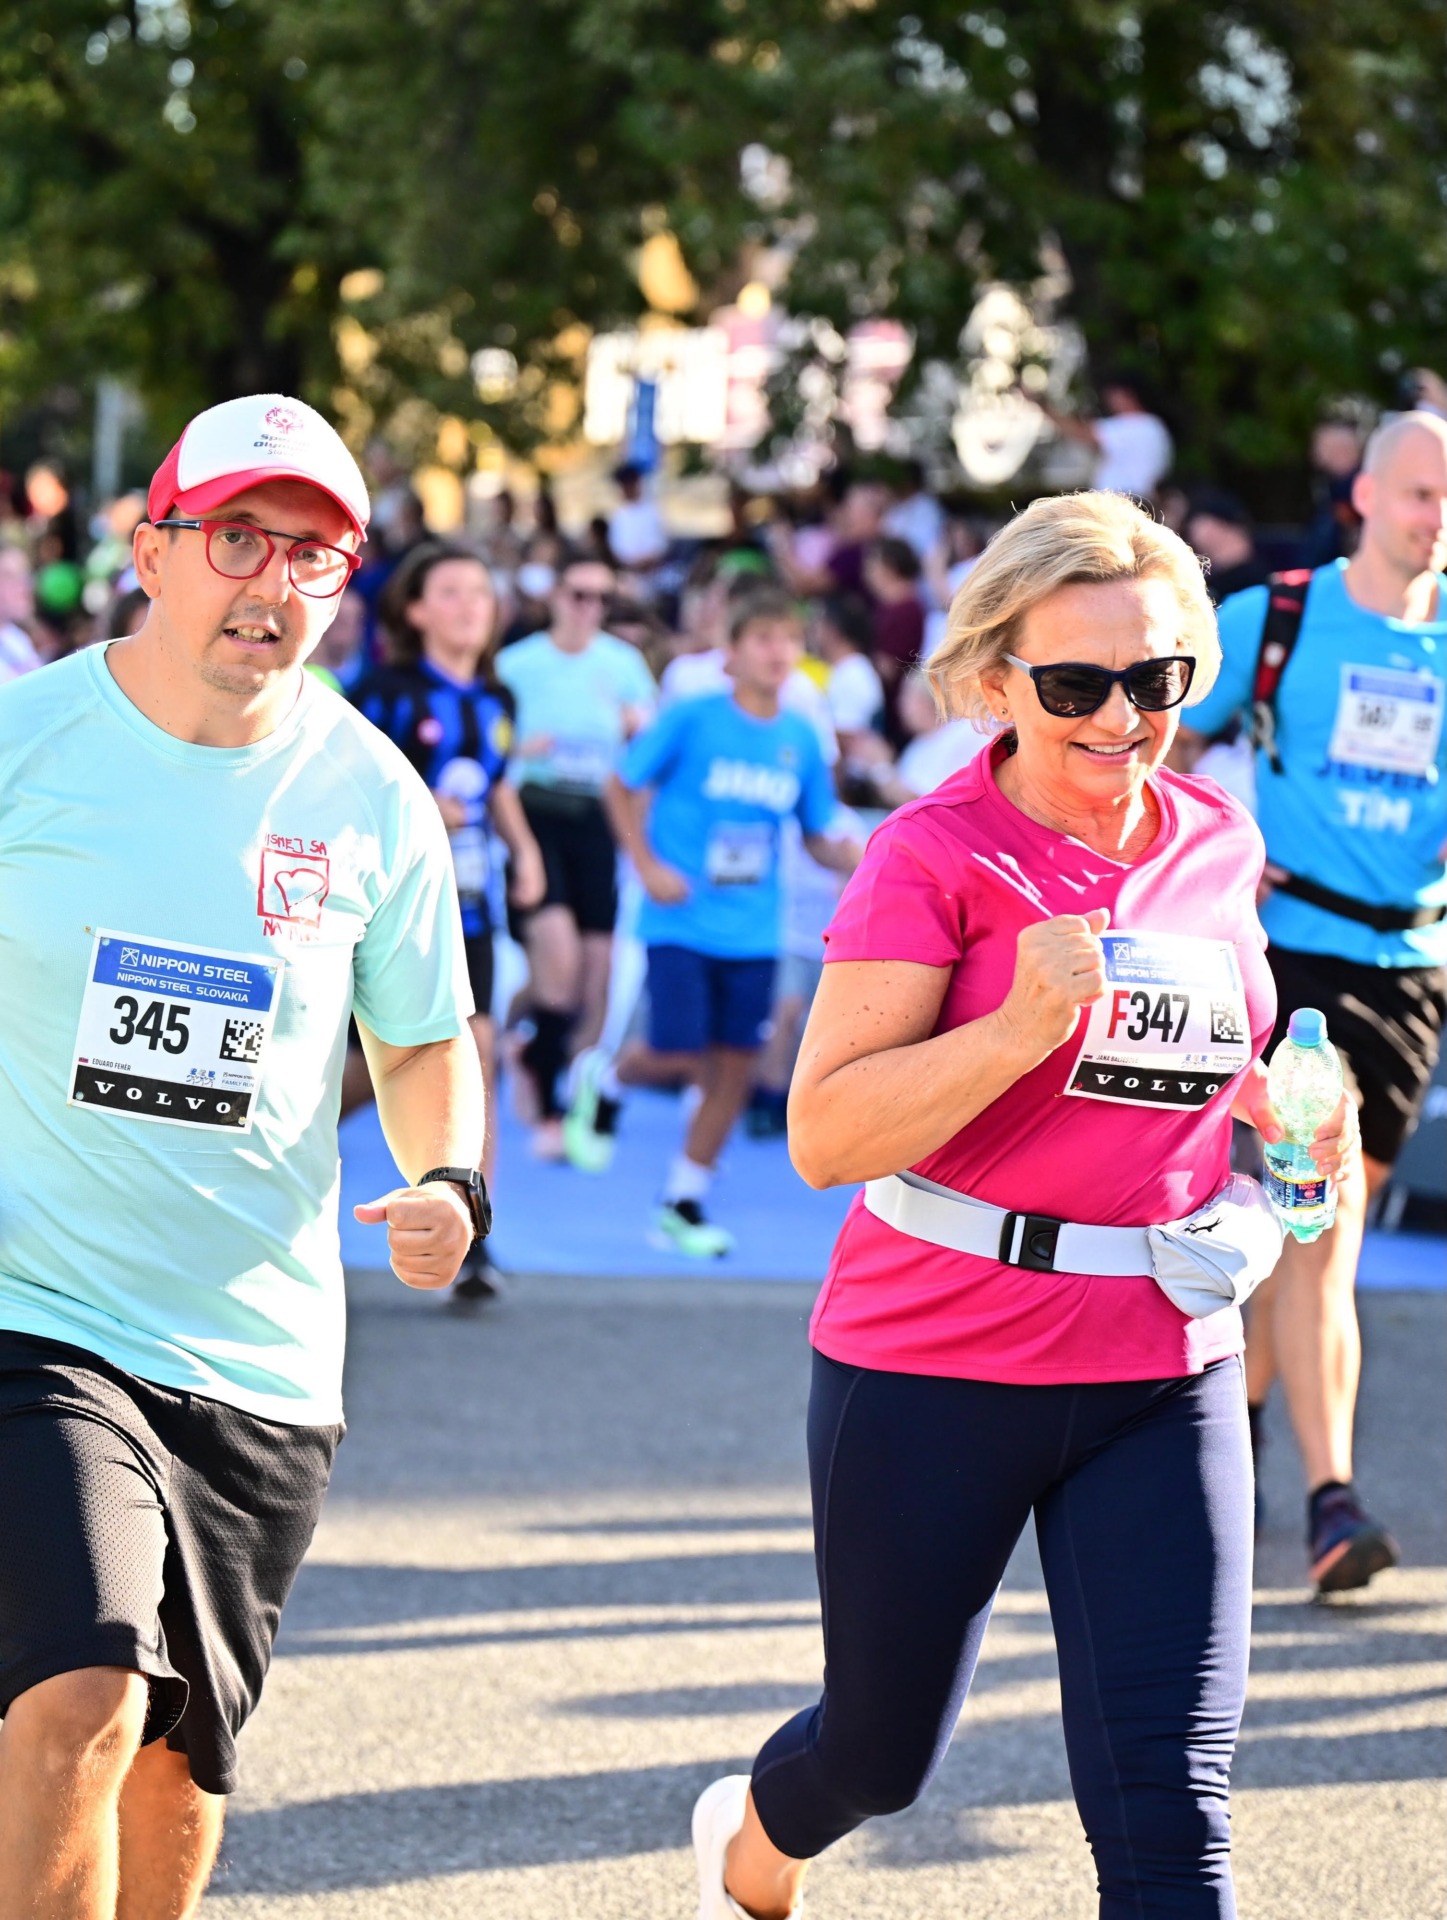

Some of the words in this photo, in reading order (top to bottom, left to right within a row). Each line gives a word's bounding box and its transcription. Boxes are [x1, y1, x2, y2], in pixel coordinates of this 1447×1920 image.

[310, 840, 327, 855] SA
[141, 953, 200, 975] NIPPON
[203, 965, 252, 984] STEEL
[117, 972, 157, 987] NIPPON
[159, 980, 193, 994] STEEL
[196, 987, 248, 1003] SLOVAKIA
[109, 995, 191, 1055] 345
[1107, 989, 1190, 1043] F347
[92, 1058, 114, 1068] EDUARD
[95, 1081, 231, 1114] VOLVO
[221, 1079, 242, 1087] FAMILY
[1096, 1073, 1219, 1095] VOLVO
